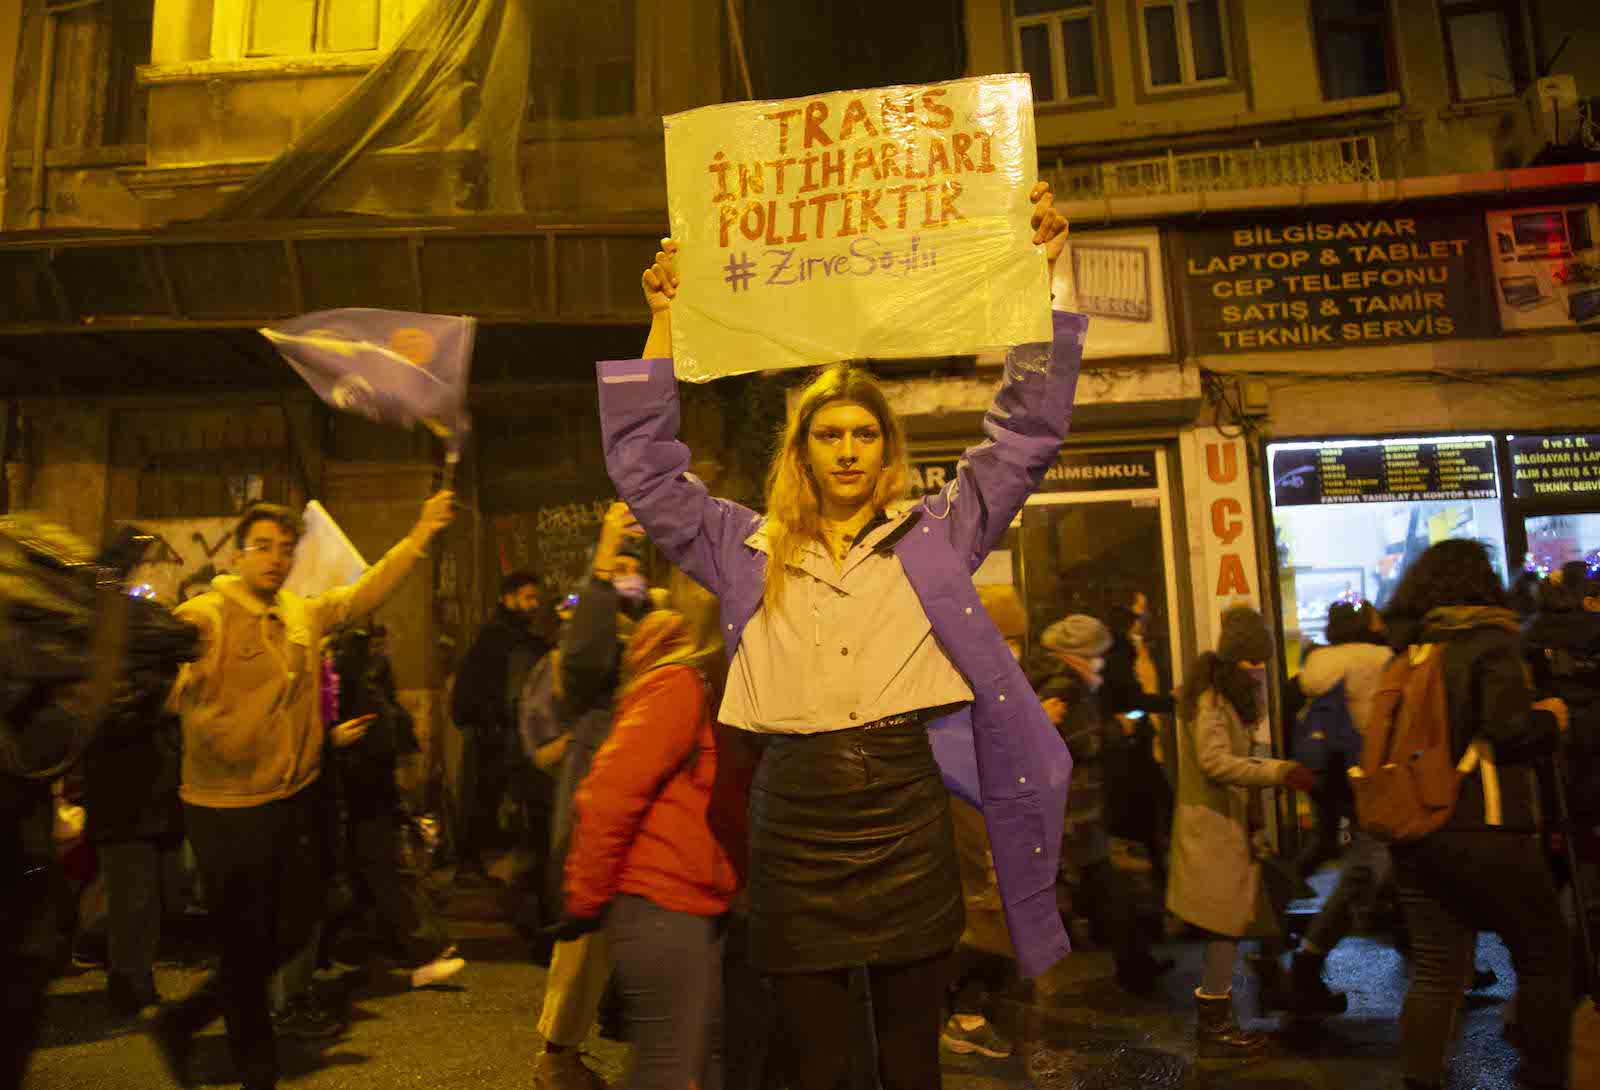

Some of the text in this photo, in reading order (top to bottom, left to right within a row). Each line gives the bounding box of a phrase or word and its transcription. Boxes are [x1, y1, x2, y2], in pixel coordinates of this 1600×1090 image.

[764, 88, 955, 156] TRANS
[1233, 218, 1417, 248] BİLGİSAYAR
[1187, 239, 1468, 275] LAPTOP & TABLET
[1212, 266, 1449, 299] CEP TELEFONU
[1222, 291, 1447, 324] SATIŞ & TAMİR
[1217, 313, 1455, 350] TEKNİK SERVİS
[1513, 451, 1570, 465] BİLGİSAYAR
[1515, 467, 1540, 479] ALIM
[1532, 480, 1571, 493] TEKNİK
[1205, 441, 1252, 622] UÇA
